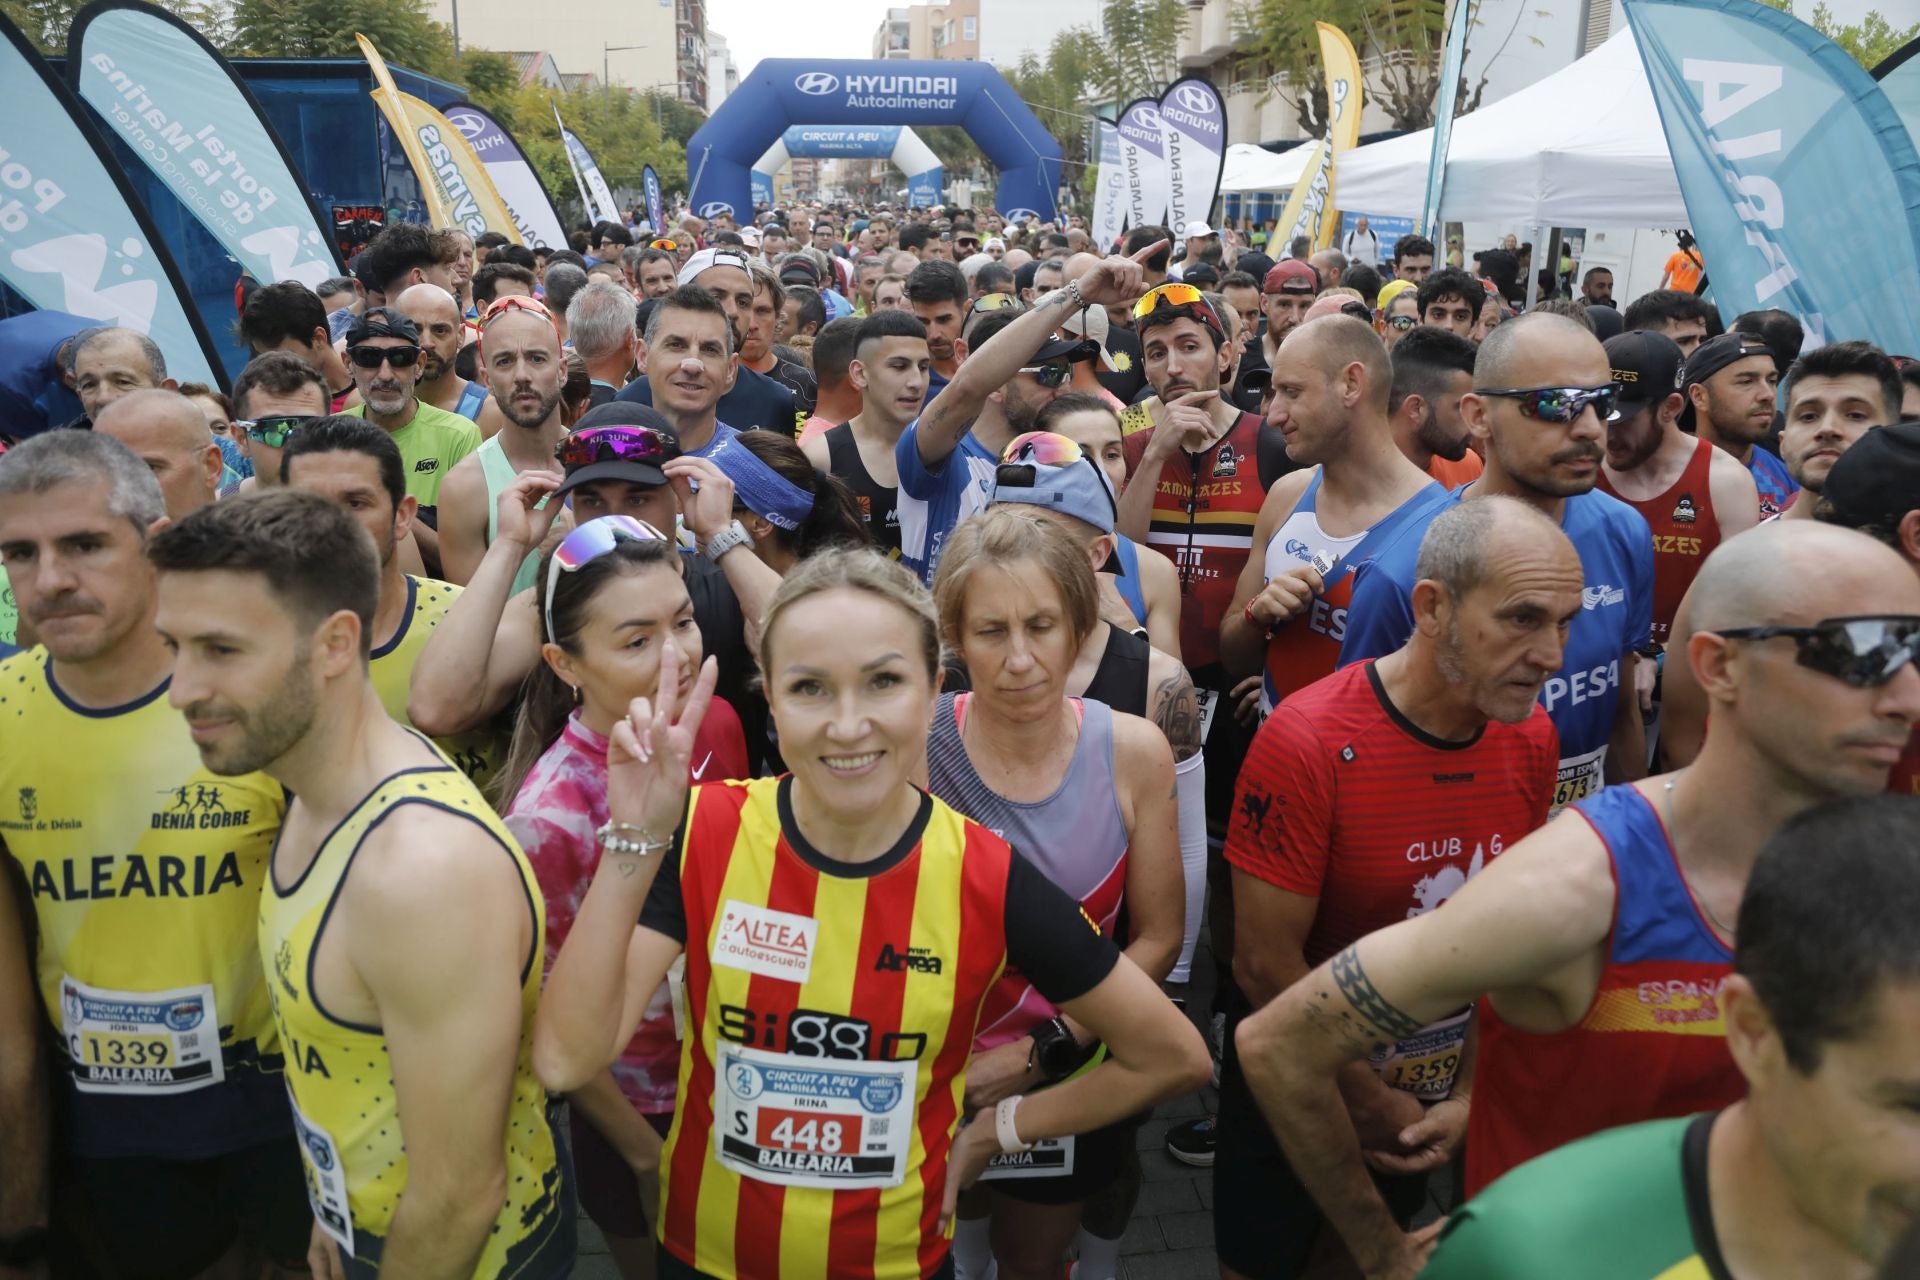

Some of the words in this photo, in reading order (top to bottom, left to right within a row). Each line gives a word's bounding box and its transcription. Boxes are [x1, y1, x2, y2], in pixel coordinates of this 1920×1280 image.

[845, 75, 958, 95] HYUNDAI
[846, 94, 957, 109] Autoalmenar
[801, 132, 845, 142] CIRCUIT
[847, 133, 855, 141] A
[857, 133, 880, 142] PEU
[200, 810, 251, 830] CORRE
[1406, 837, 1462, 862] CLUB
[734, 917, 808, 951] ALTEA
[728, 944, 807, 971] autoescuela
[83, 1001, 125, 1014] CIRCUIT
[126, 1006, 135, 1014] A
[137, 1006, 161, 1014] PEU
[110, 1023, 139, 1033] JORDI
[89, 1038, 168, 1065] 1339
[89, 1066, 174, 1082] BALEARIA
[766, 1070, 818, 1085] CIRCUIT
[817, 1074, 829, 1085] A
[831, 1075, 859, 1087] PEU
[1394, 1054, 1458, 1083] 1359
[773, 1083, 818, 1094] MARINA
[820, 1086, 850, 1097] ALTA
[794, 1097, 828, 1109] IRINA
[734, 1110, 749, 1136] S
[770, 1116, 843, 1153] 448
[758, 1149, 854, 1173] BALEARIA
